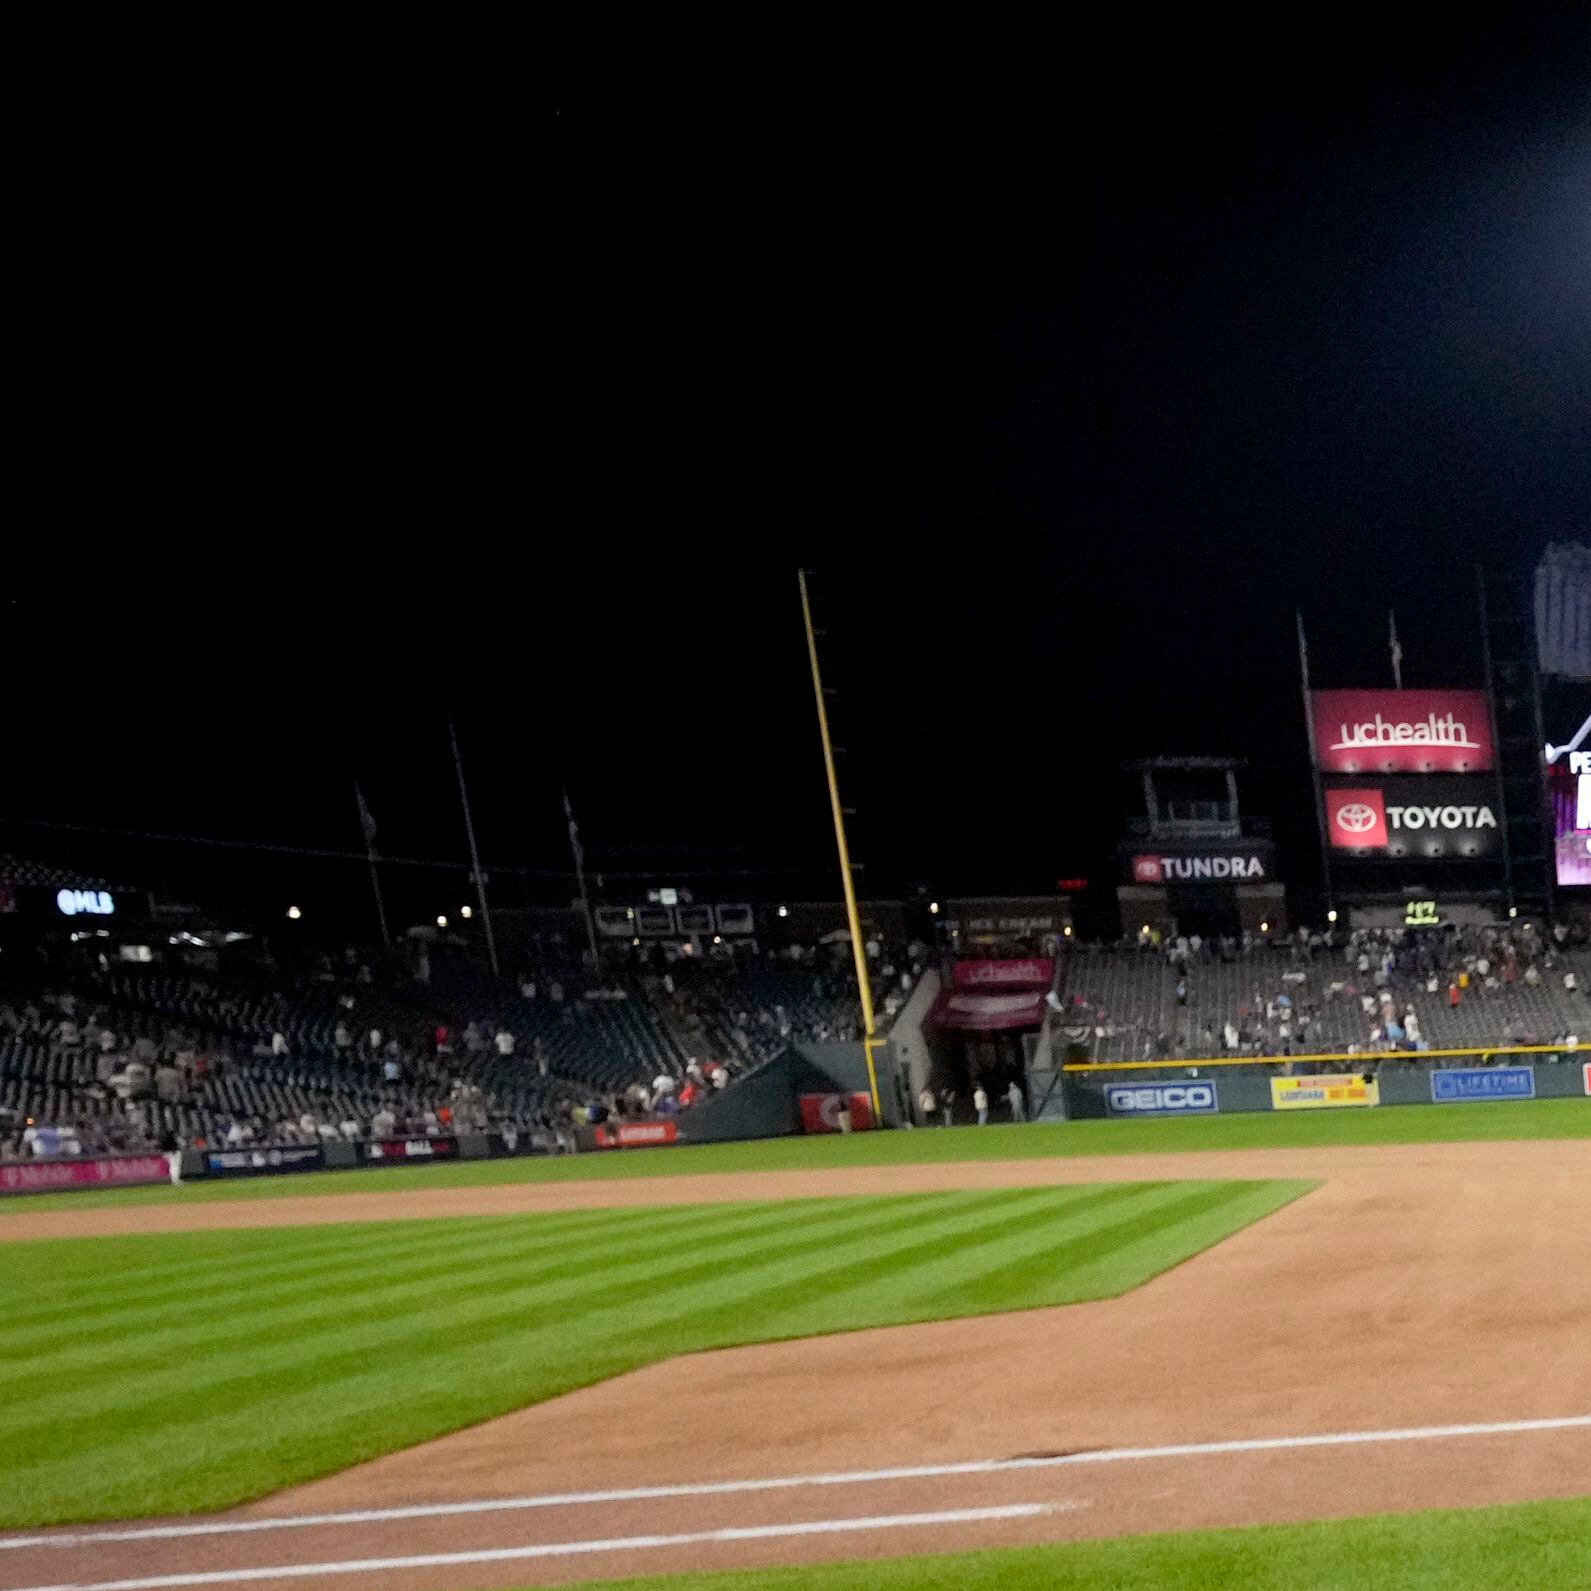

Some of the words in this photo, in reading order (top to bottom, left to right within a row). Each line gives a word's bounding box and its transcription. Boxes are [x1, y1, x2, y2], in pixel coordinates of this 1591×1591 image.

[1341, 713, 1467, 745] uchealth
[1386, 806, 1496, 829] TOYOTA
[1161, 856, 1263, 879] TUNDRA
[1110, 1087, 1213, 1112] GEICO
